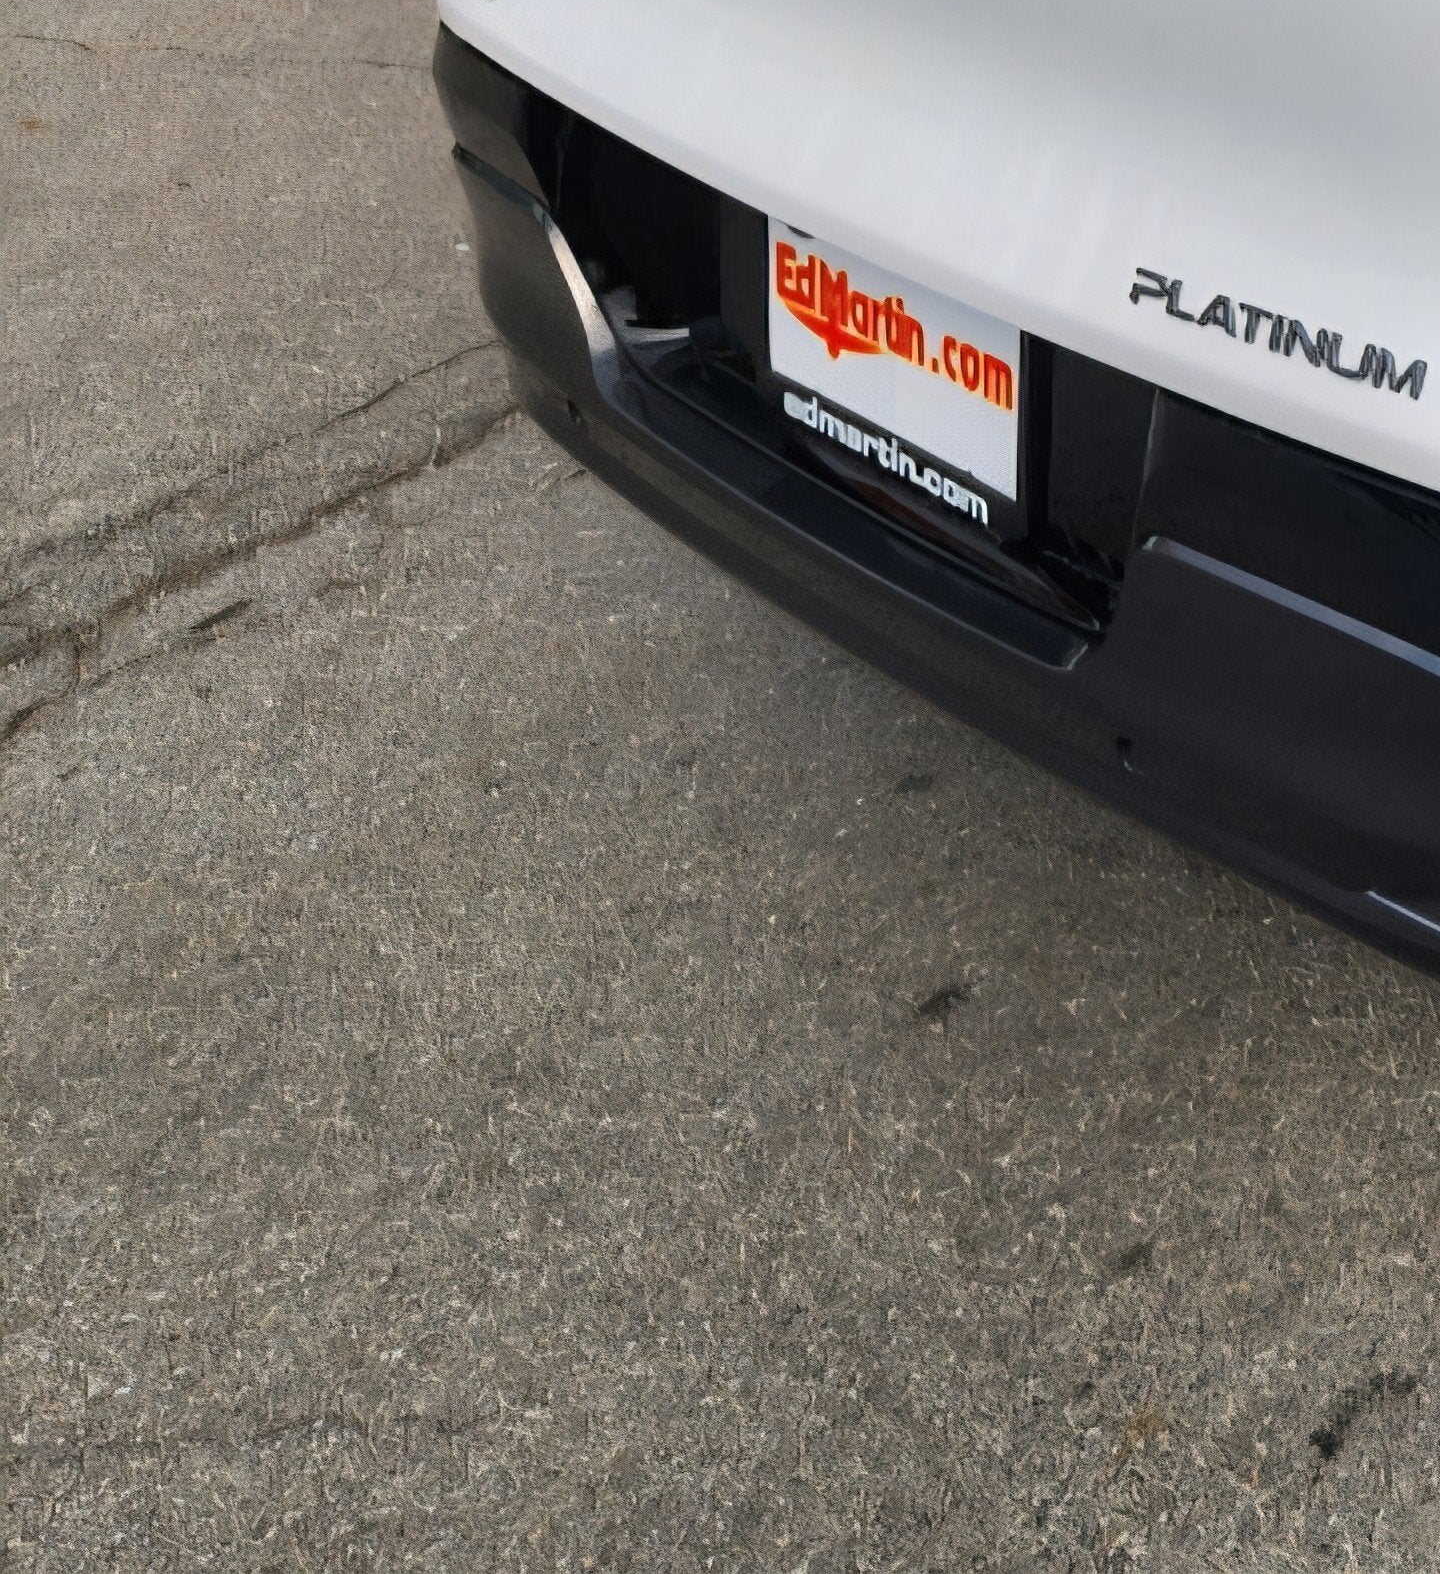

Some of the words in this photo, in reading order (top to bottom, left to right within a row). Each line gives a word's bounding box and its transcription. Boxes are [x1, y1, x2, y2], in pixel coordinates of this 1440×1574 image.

[775, 240, 1016, 411] EdMartin.com
[1129, 267, 1428, 401] PLATINUM
[783, 391, 989, 526] edmartin.com
